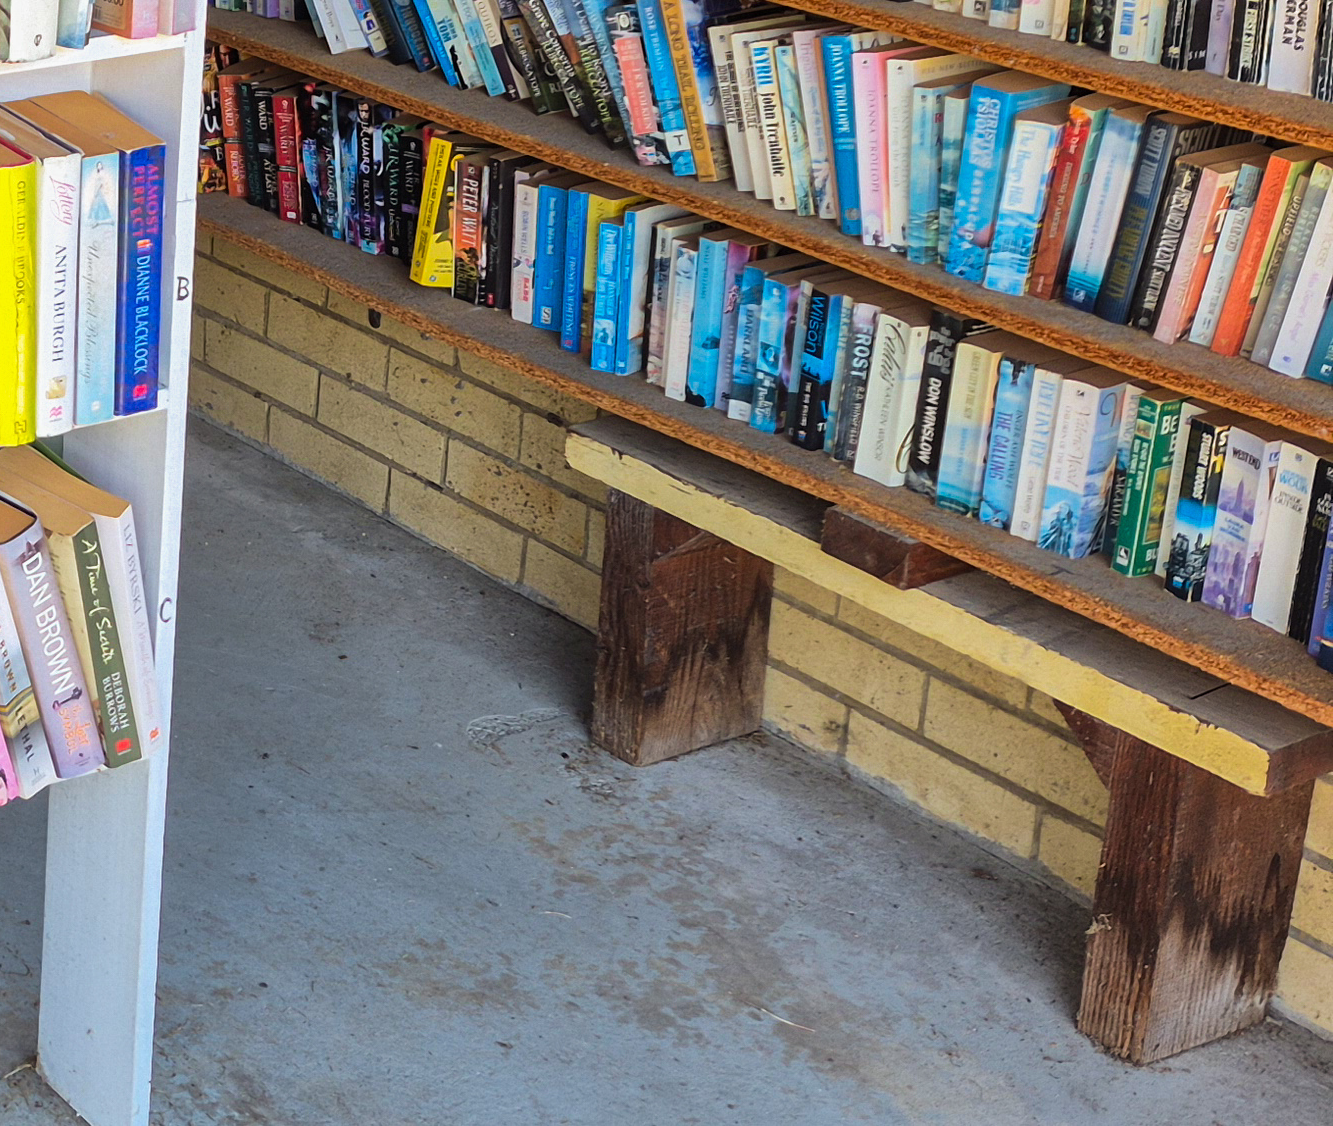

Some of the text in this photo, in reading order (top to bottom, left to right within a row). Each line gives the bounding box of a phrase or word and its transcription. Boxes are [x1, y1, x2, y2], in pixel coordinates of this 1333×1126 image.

[145, 164, 159, 236] ALMOST
[461, 178, 480, 247] PETER WATT
[50, 244, 67, 363] ANITA BURGH
[133, 254, 151, 374] DIANNE BLACKLOCK
[176, 276, 190, 301] B
[850, 326, 873, 381] FROST
[918, 377, 942, 465] DON WINSLOW
[22, 552, 75, 695] DAN BROWN
[159, 597, 171, 622] C
[102, 676, 119, 733] BURROWS
[111, 672, 130, 729] DEBORAH
[14, 706, 35, 762] LETHAL
